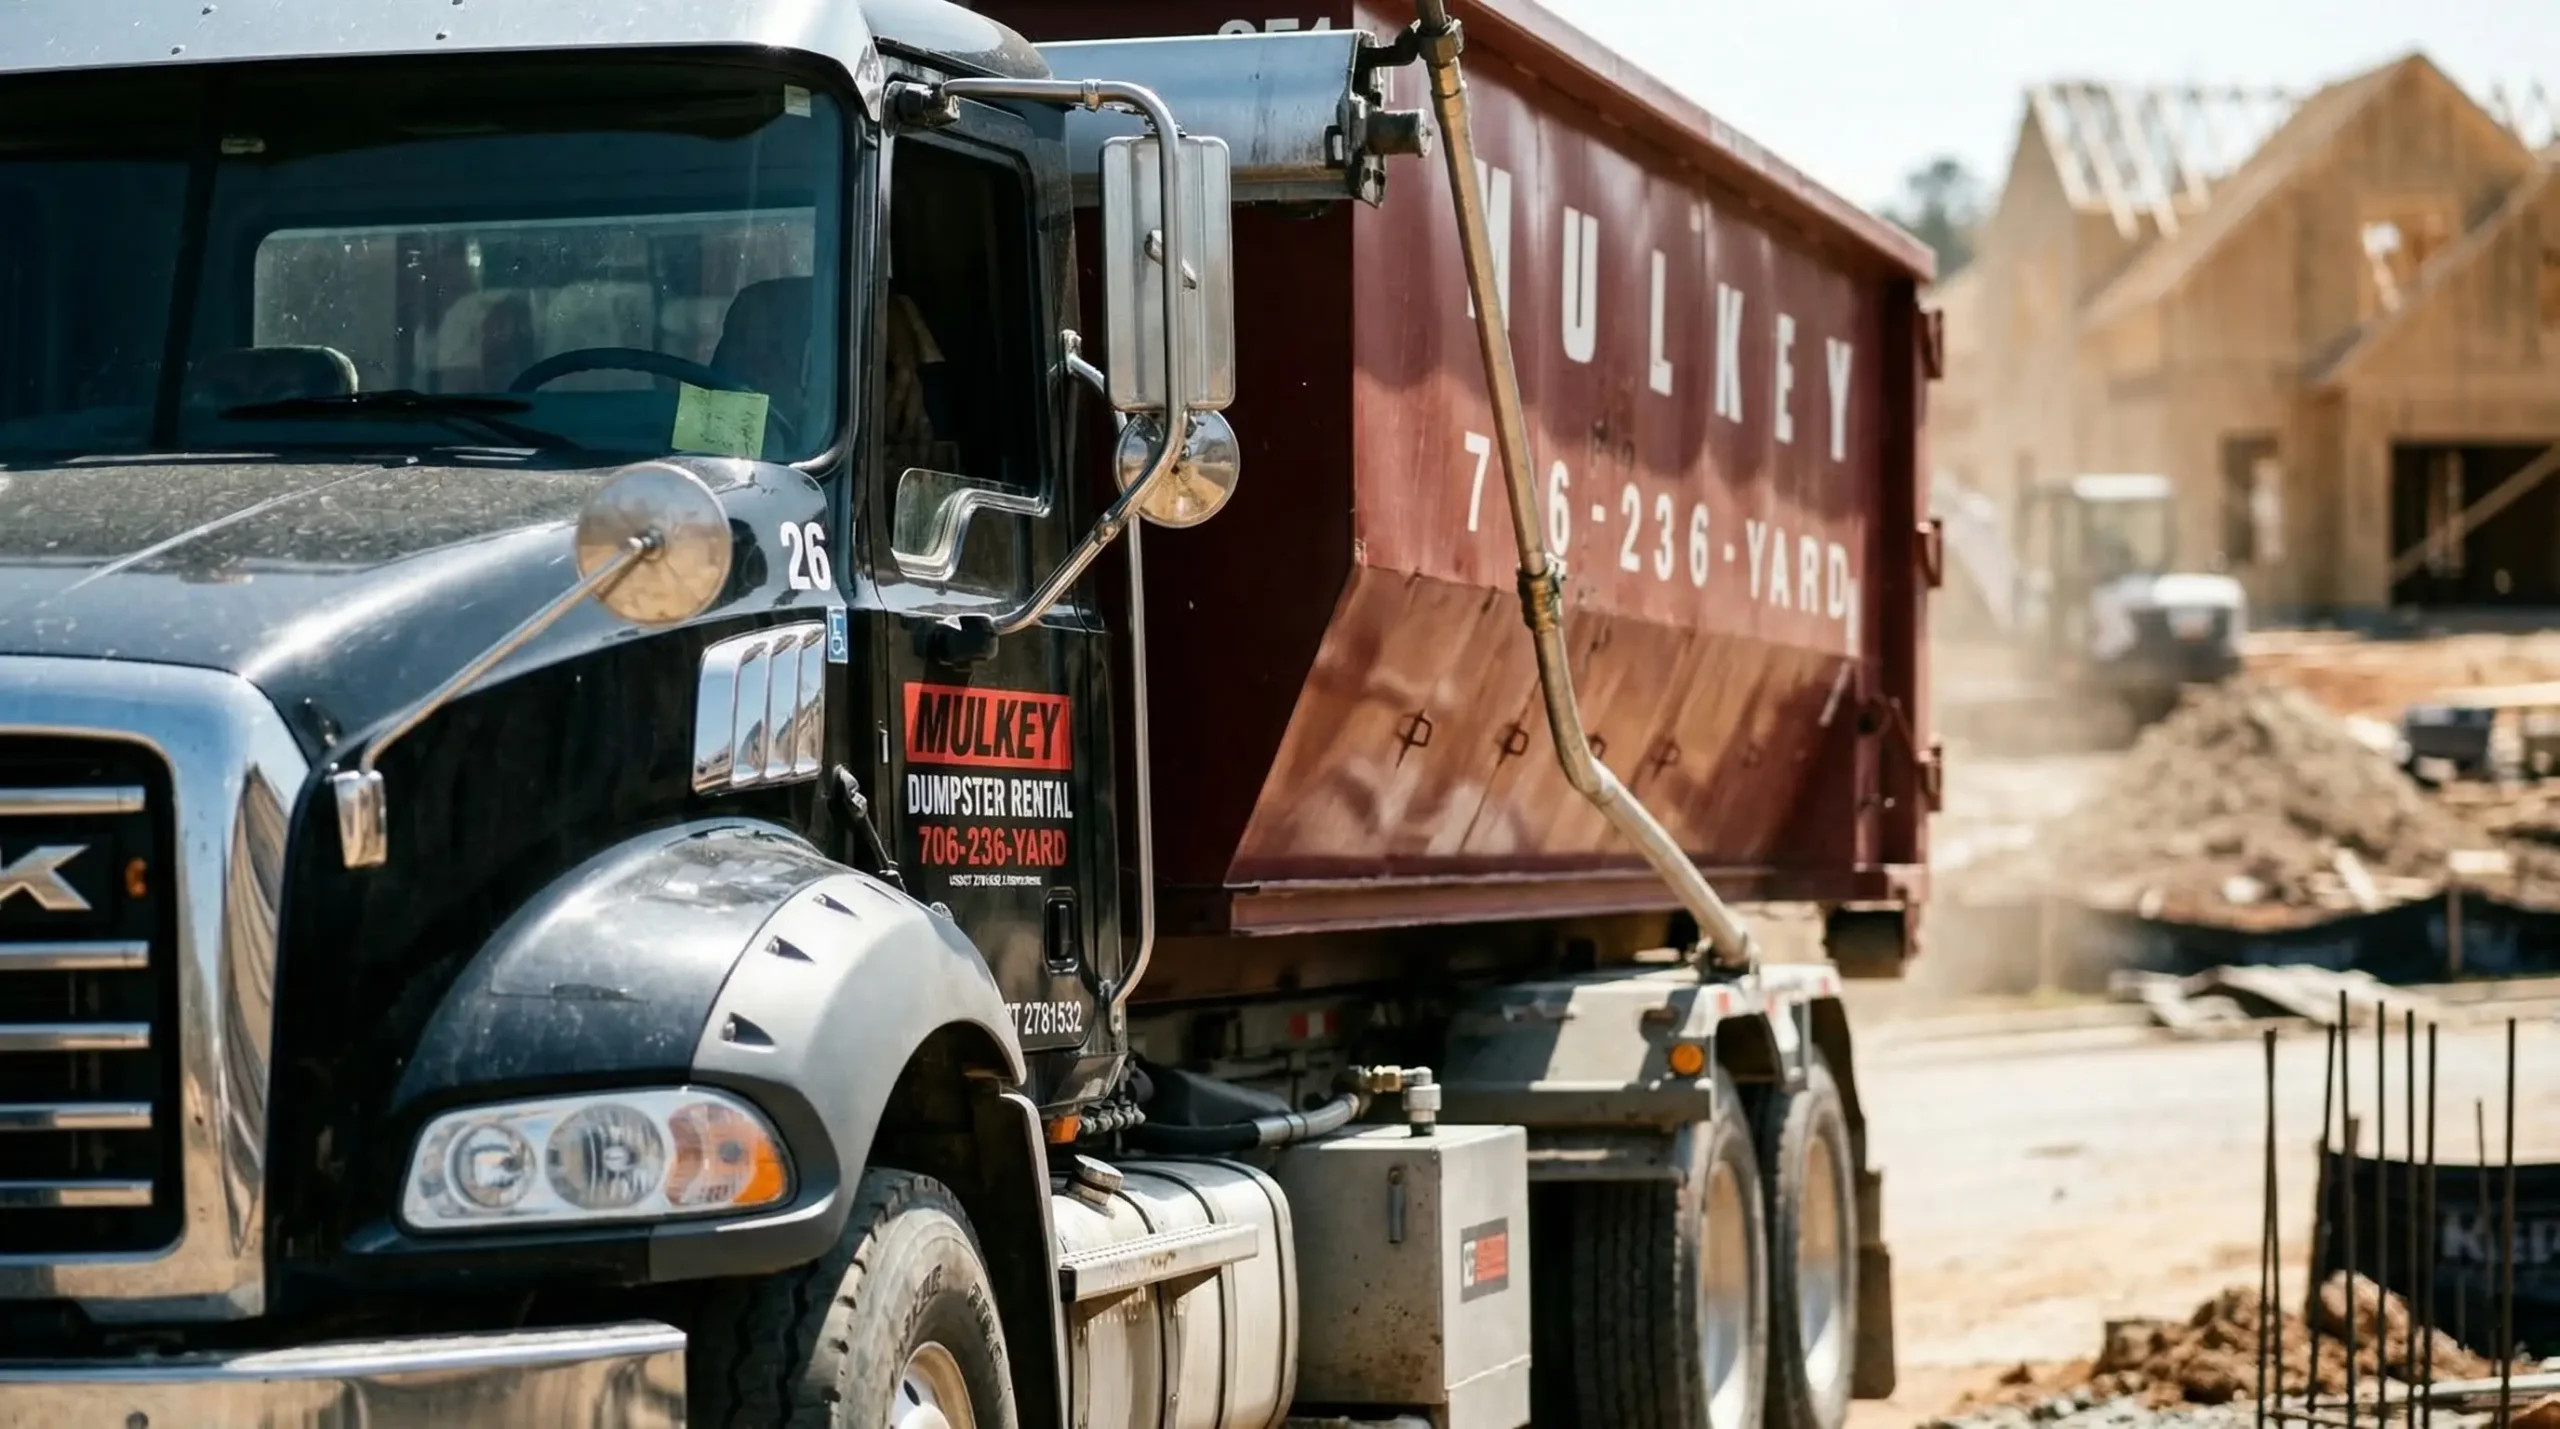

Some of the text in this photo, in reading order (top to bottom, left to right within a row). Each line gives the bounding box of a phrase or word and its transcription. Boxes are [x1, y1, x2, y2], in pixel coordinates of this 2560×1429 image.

[1465, 431, 1849, 620] 76-236-YARD
[780, 521, 831, 591] 26
[915, 692, 1061, 760] MULKEY
[908, 774, 1074, 818] DUMPSTER RENTAL
[919, 826, 1067, 867] 706-236-YARD
[1024, 1001, 1082, 1034] 2781532
